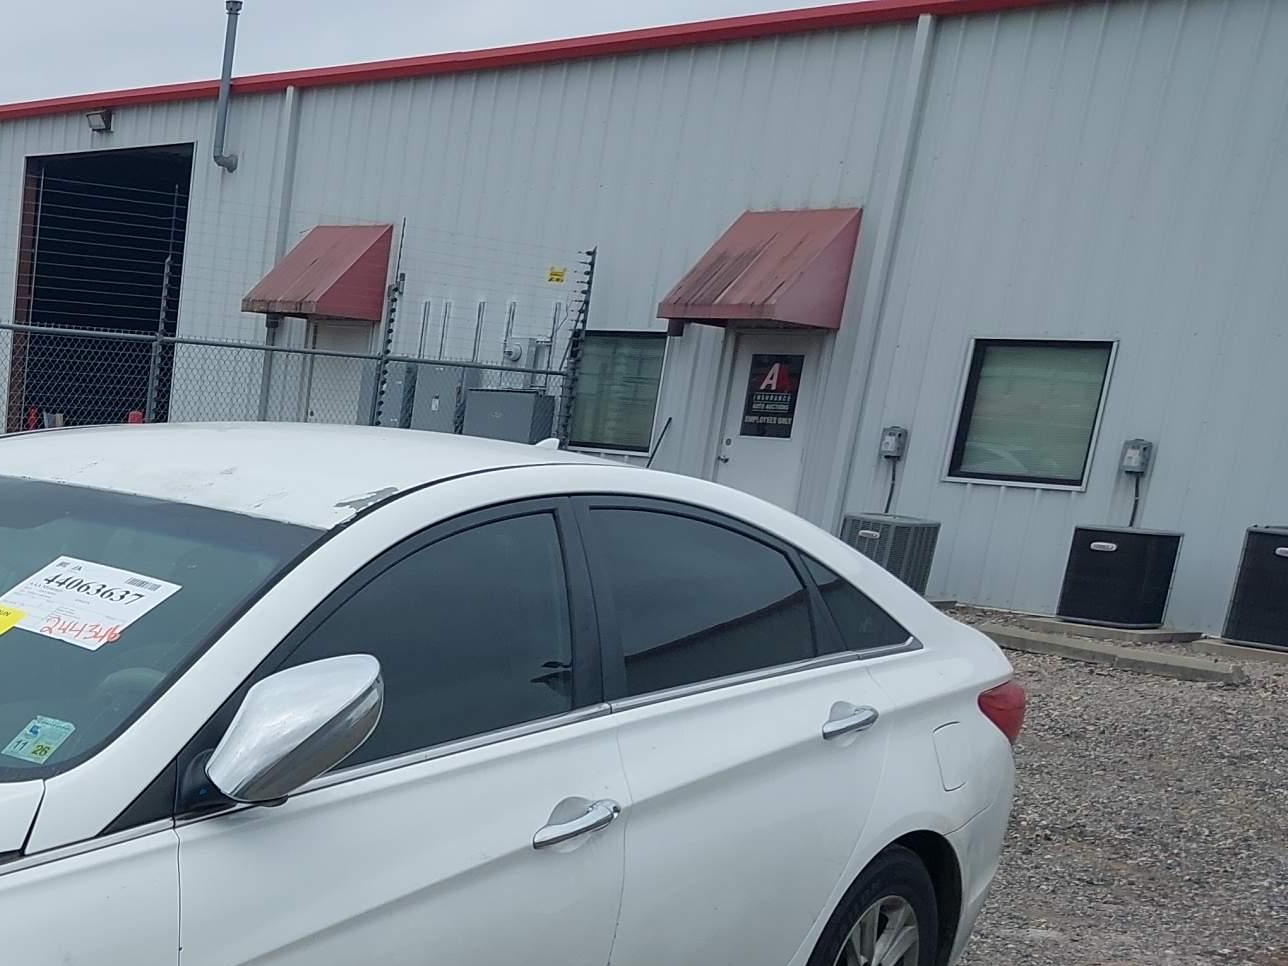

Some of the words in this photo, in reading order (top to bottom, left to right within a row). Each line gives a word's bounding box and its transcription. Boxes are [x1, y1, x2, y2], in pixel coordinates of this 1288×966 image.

[44, 573, 145, 606] 44063637
[13, 739, 29, 751] 11
[32, 744, 50, 757] 26
